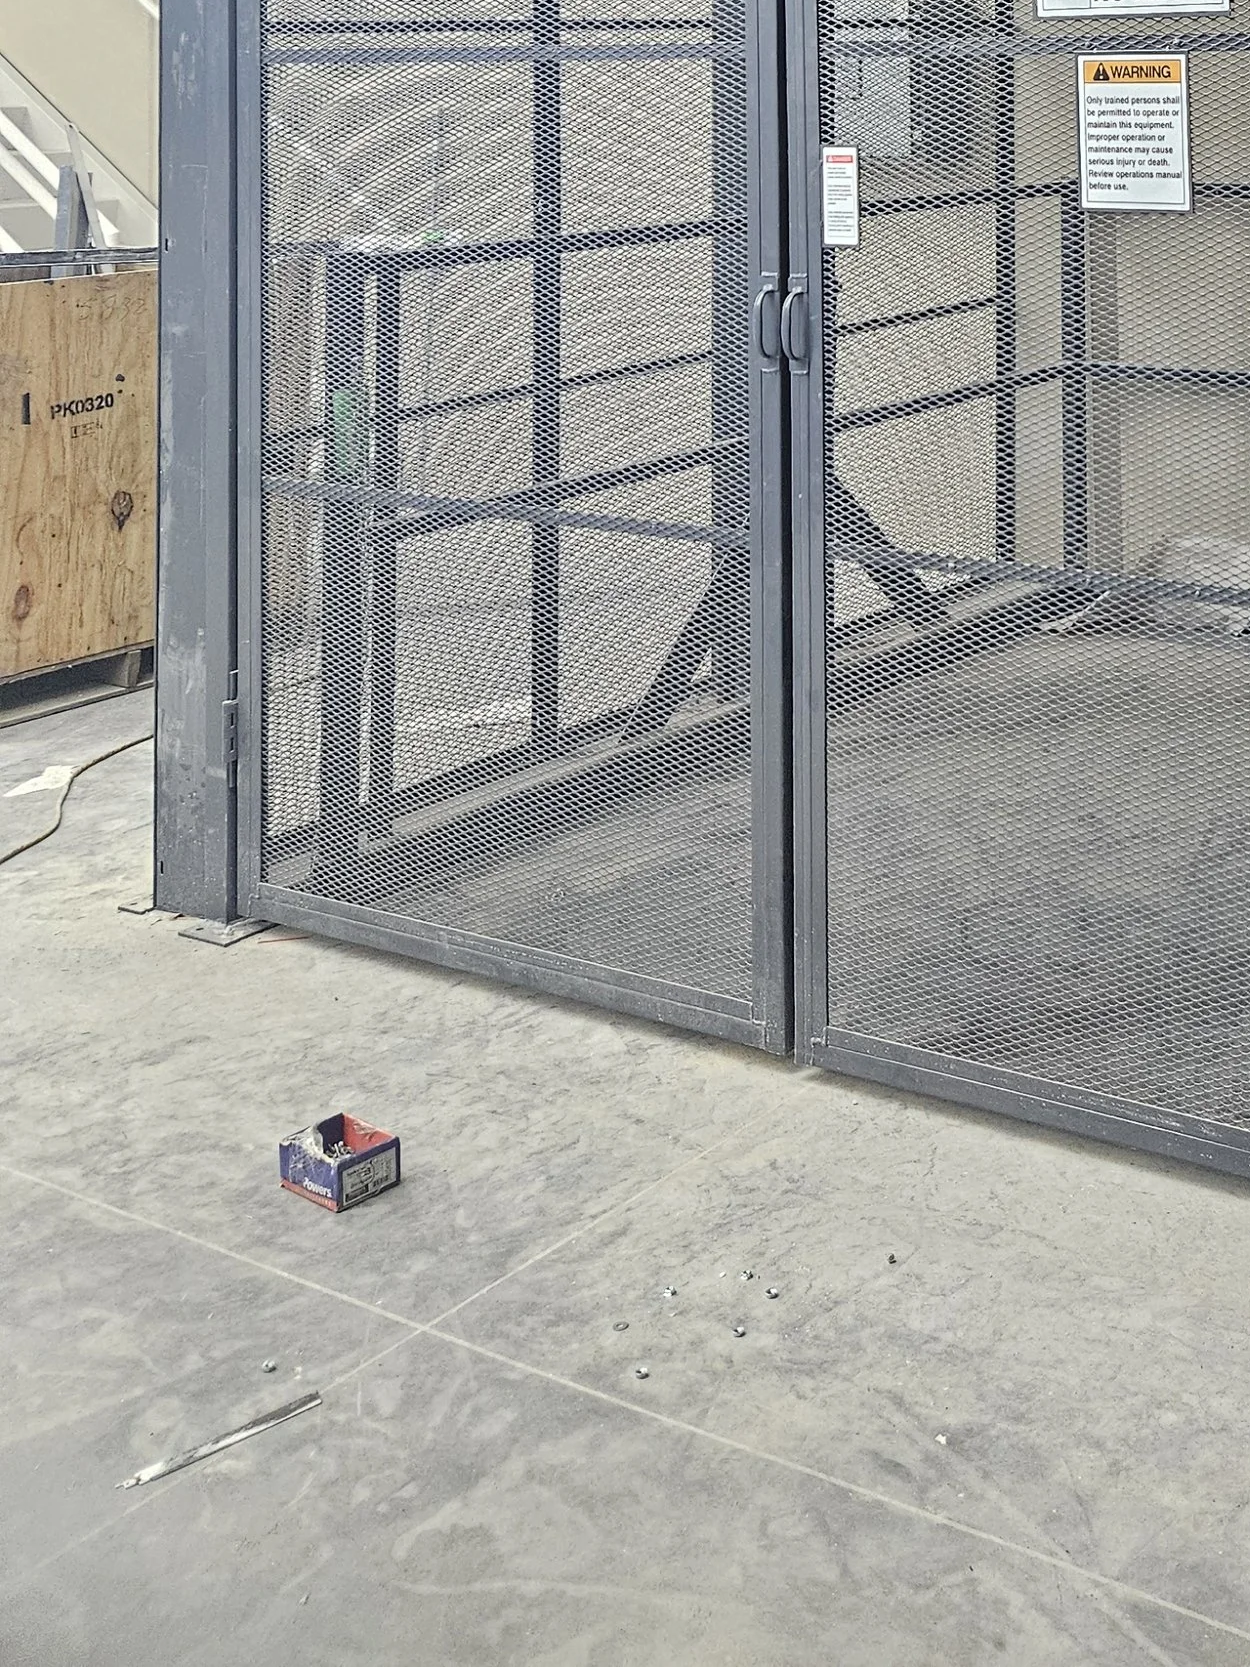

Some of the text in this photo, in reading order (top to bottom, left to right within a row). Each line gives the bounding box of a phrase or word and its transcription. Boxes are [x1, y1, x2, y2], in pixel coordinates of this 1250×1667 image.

[1110, 65, 1171, 79] WARNING
[1086, 96, 1180, 106] Only trained persons shall
[1097, 109, 1131, 118] permitted
[1142, 109, 1170, 118] operate
[1087, 121, 1174, 130] maintain this equipment.
[1088, 134, 1119, 142] Improper
[1121, 134, 1156, 142] operation
[1135, 147, 1150, 155] may
[1116, 158, 1136, 168] injury
[1147, 158, 1170, 166] death.
[1088, 170, 1114, 178] Review
[1116, 170, 1154, 179] operations
[1089, 182, 1112, 190] before
[51, 393, 114, 420] PK0320
